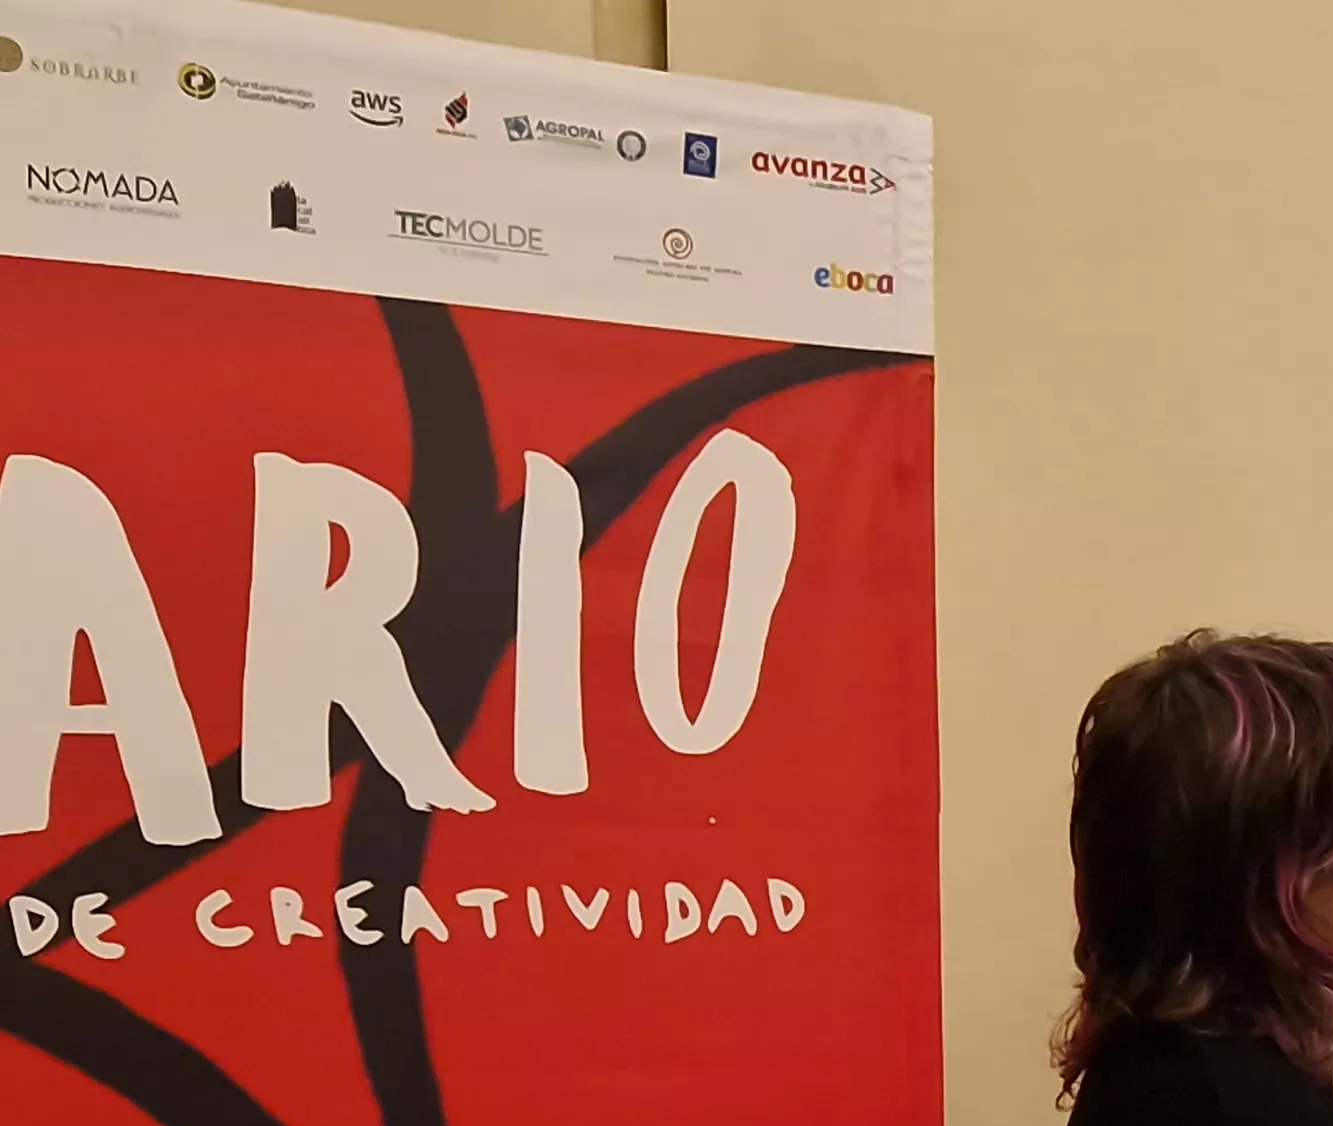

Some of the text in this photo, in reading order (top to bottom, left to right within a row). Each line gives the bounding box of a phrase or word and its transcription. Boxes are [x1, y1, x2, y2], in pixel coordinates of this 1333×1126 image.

[351, 89, 401, 114] aws
[536, 120, 605, 141] AGROPAL
[28, 163, 179, 205] NOMADA
[752, 152, 866, 185] avanza
[394, 209, 543, 251] TECMOLDE
[814, 262, 893, 294] eboca
[9, 878, 806, 959] DE CREATIVIDAD
